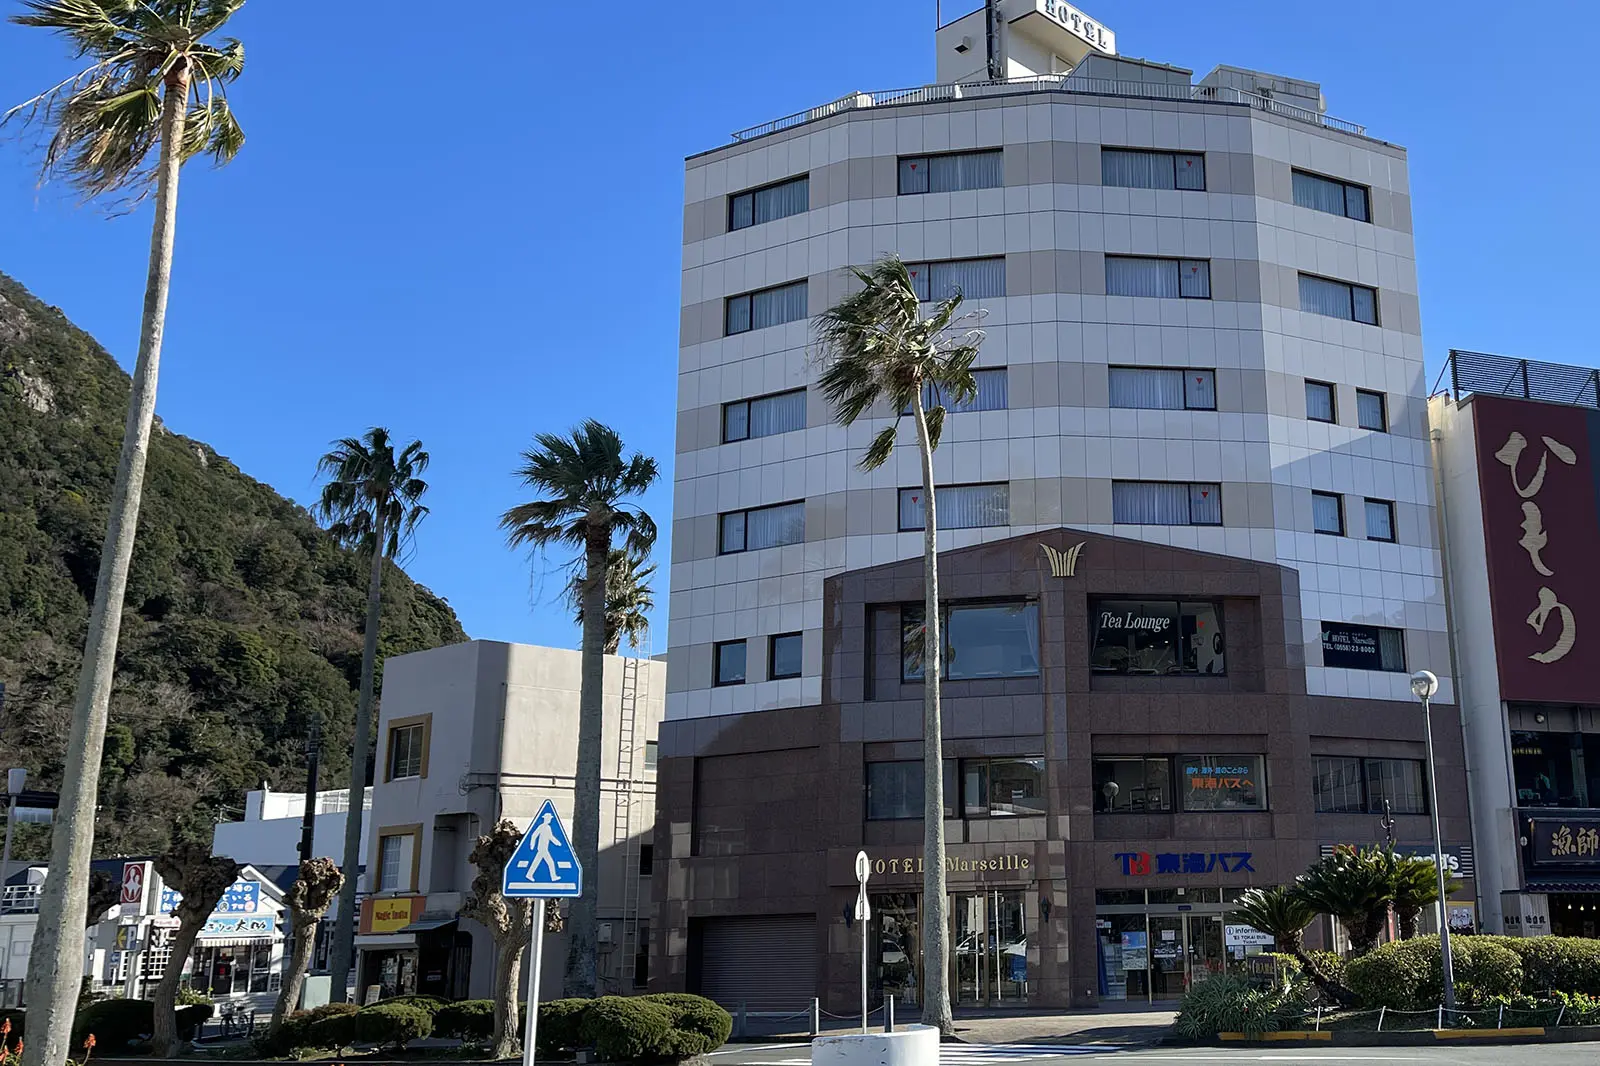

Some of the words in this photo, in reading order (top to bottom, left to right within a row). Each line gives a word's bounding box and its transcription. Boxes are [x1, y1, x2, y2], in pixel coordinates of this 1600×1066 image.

[1045, 0, 1107, 50] HOTEL
[1494, 431, 1577, 664] ひもの
[1101, 611, 1122, 629] Tea
[1124, 612, 1170, 633] Lounge
[1191, 778, 1255, 789] 東海バスへ
[945, 855, 1030, 872] Marseille
[1156, 852, 1256, 874] 東海バス
